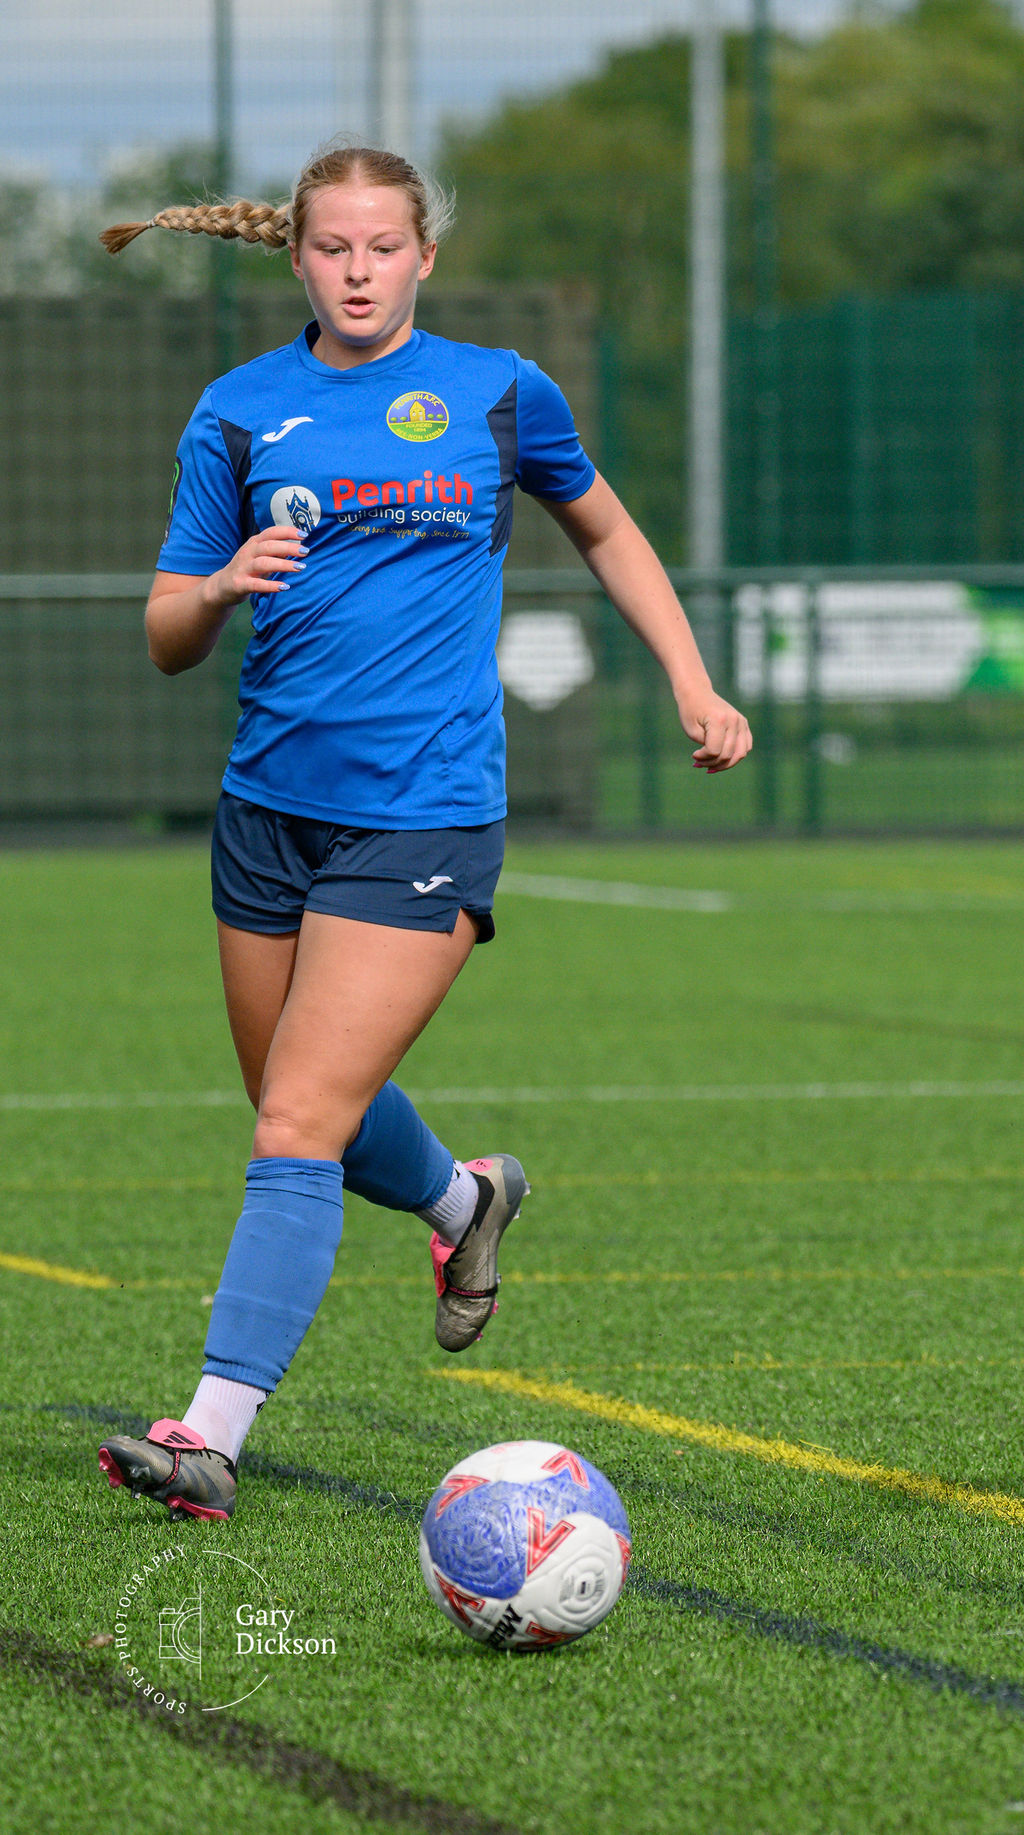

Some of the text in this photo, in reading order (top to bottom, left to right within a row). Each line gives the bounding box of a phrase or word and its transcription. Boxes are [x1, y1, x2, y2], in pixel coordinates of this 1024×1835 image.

[331, 470, 473, 510] Penrith
[337, 507, 471, 526] building society
